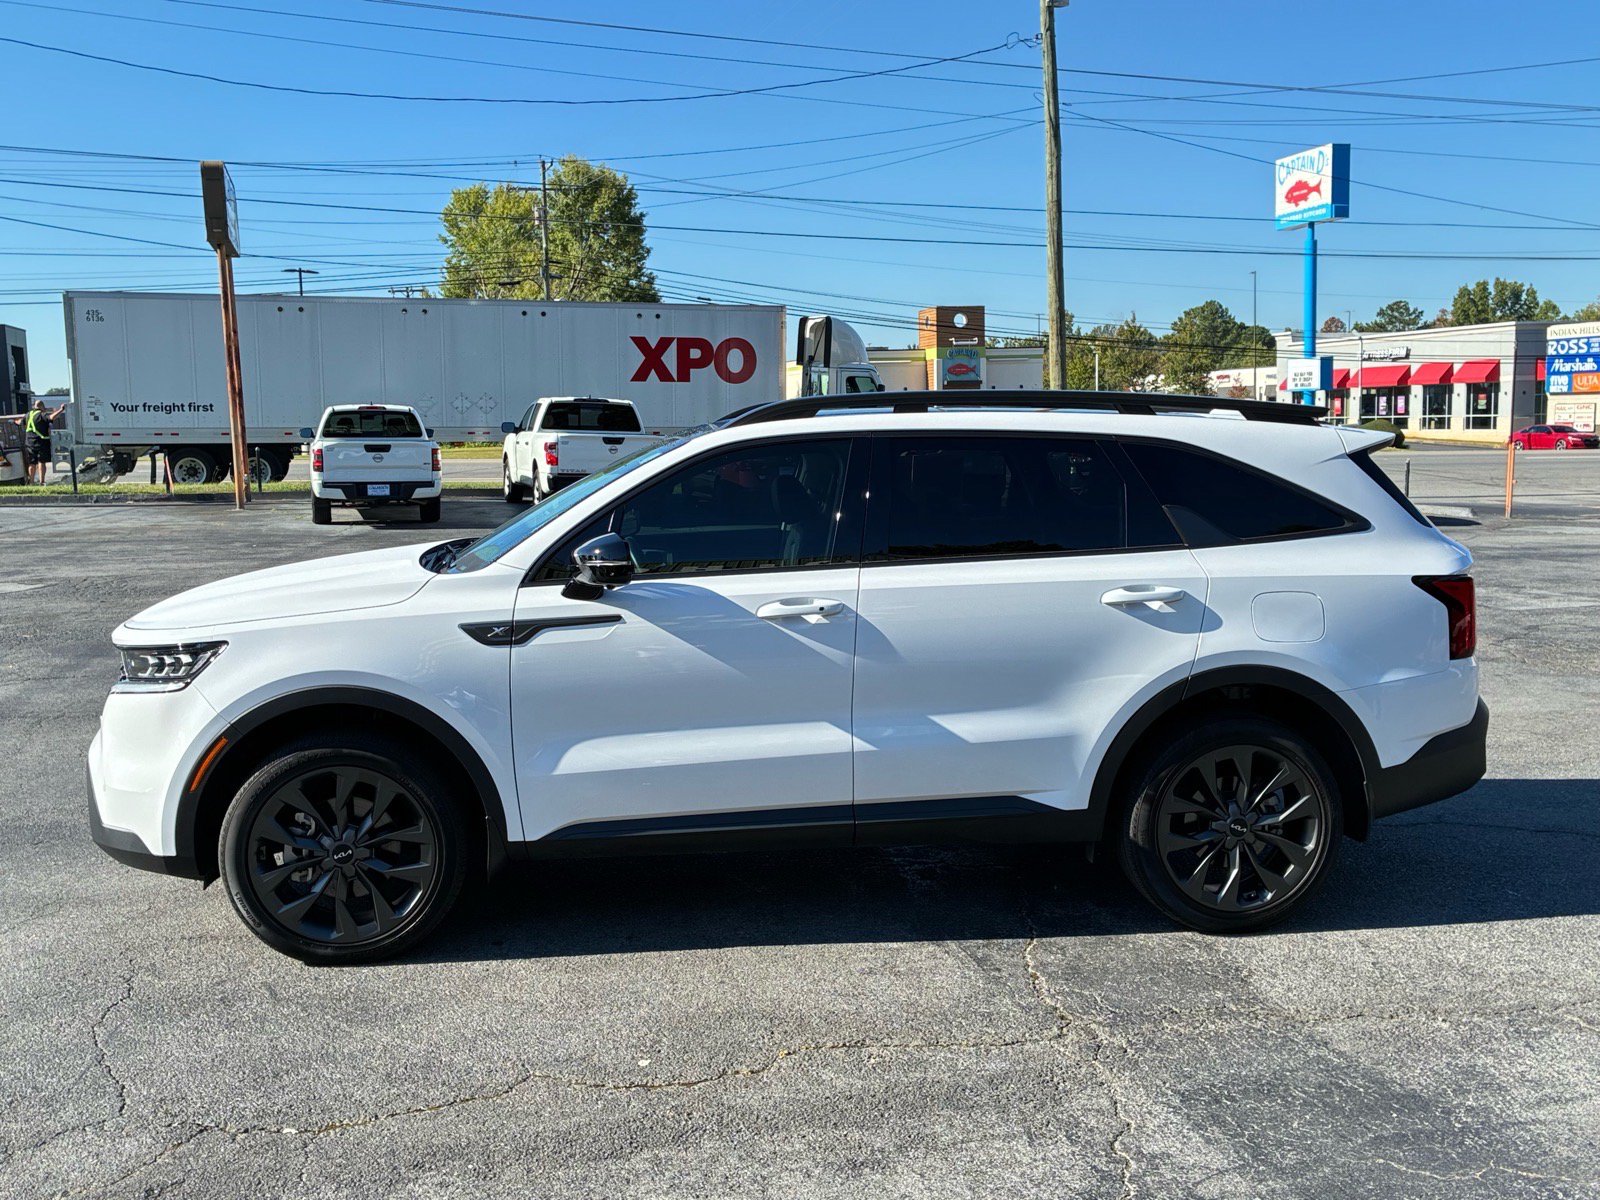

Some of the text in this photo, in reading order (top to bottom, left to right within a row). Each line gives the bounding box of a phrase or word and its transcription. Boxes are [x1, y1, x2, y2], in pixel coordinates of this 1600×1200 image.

[1278, 155, 1316, 186] CAPTAIN
[1550, 328, 1578, 337] INDIAN
[1547, 338, 1588, 355] ROSS
[629, 336, 757, 384] XPO
[1551, 358, 1597, 372] Marshalls
[1577, 375, 1599, 385] ULTA
[110, 402, 139, 412] Your
[142, 402, 185, 414] freight
[188, 402, 214, 412] first
